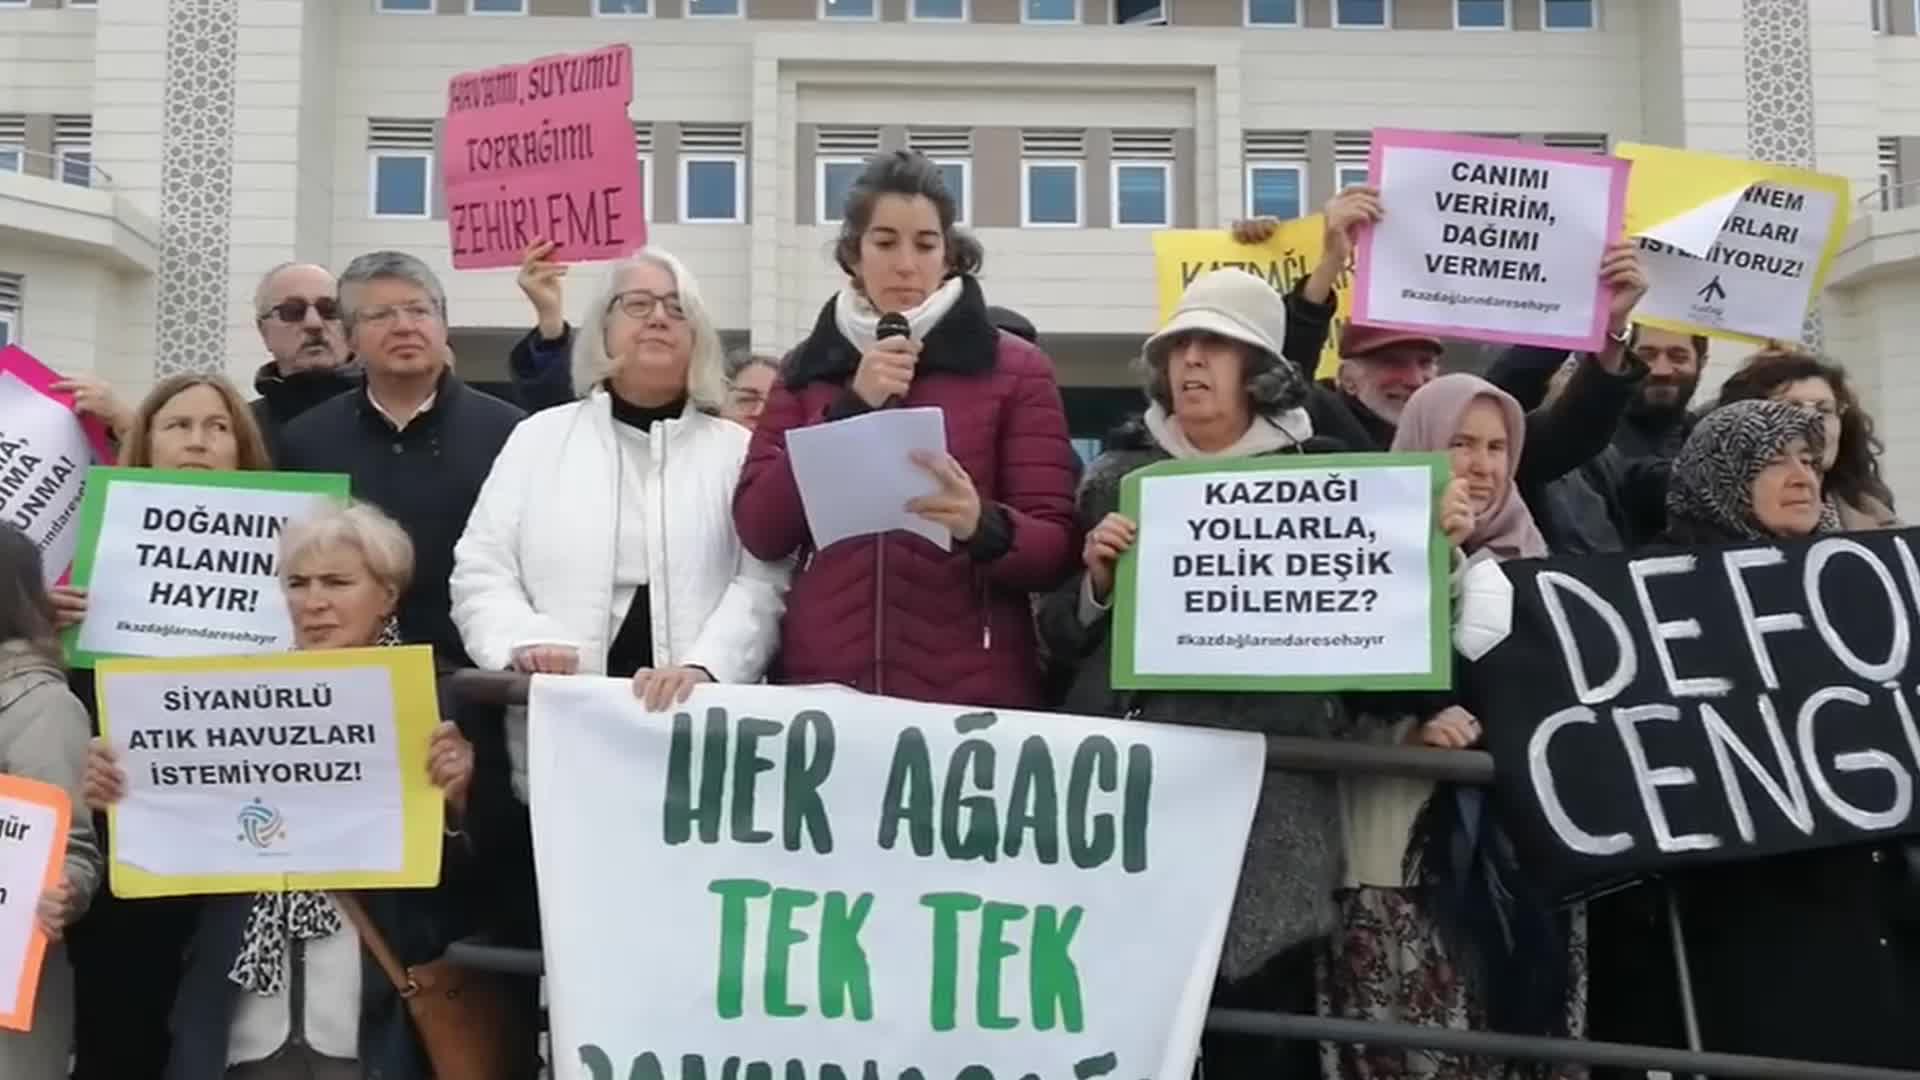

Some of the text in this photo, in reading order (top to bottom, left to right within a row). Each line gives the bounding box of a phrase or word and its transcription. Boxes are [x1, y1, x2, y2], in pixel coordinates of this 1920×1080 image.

[528, 52, 623, 100] SUYUMU
[1451, 162, 1549, 190] CANIMI
[453, 186, 625, 256] ZEHİRLEME
[1435, 191, 1556, 226] VERİRİM,
[1442, 224, 1540, 251] DAĞIMI
[1424, 253, 1547, 283] VERMEM.
[1205, 473, 1358, 505] KAZDAĞI
[1188, 516, 1377, 544] YOLLARLA,
[137, 544, 280, 577] TALANIN
[1173, 549, 1393, 582] DELİK DEŞİK
[149, 582, 259, 613] HAYIR!
[1185, 585, 1378, 613] EDİLEMEZ?
[164, 683, 332, 712] SİYANÜRLÜ
[129, 724, 376, 750] ATIK HAVUZLARI
[151, 759, 362, 786] İSTEMİYORUZ!
[663, 707, 1153, 874] HER AĞACI
[708, 879, 1084, 1034] TEK TEK
